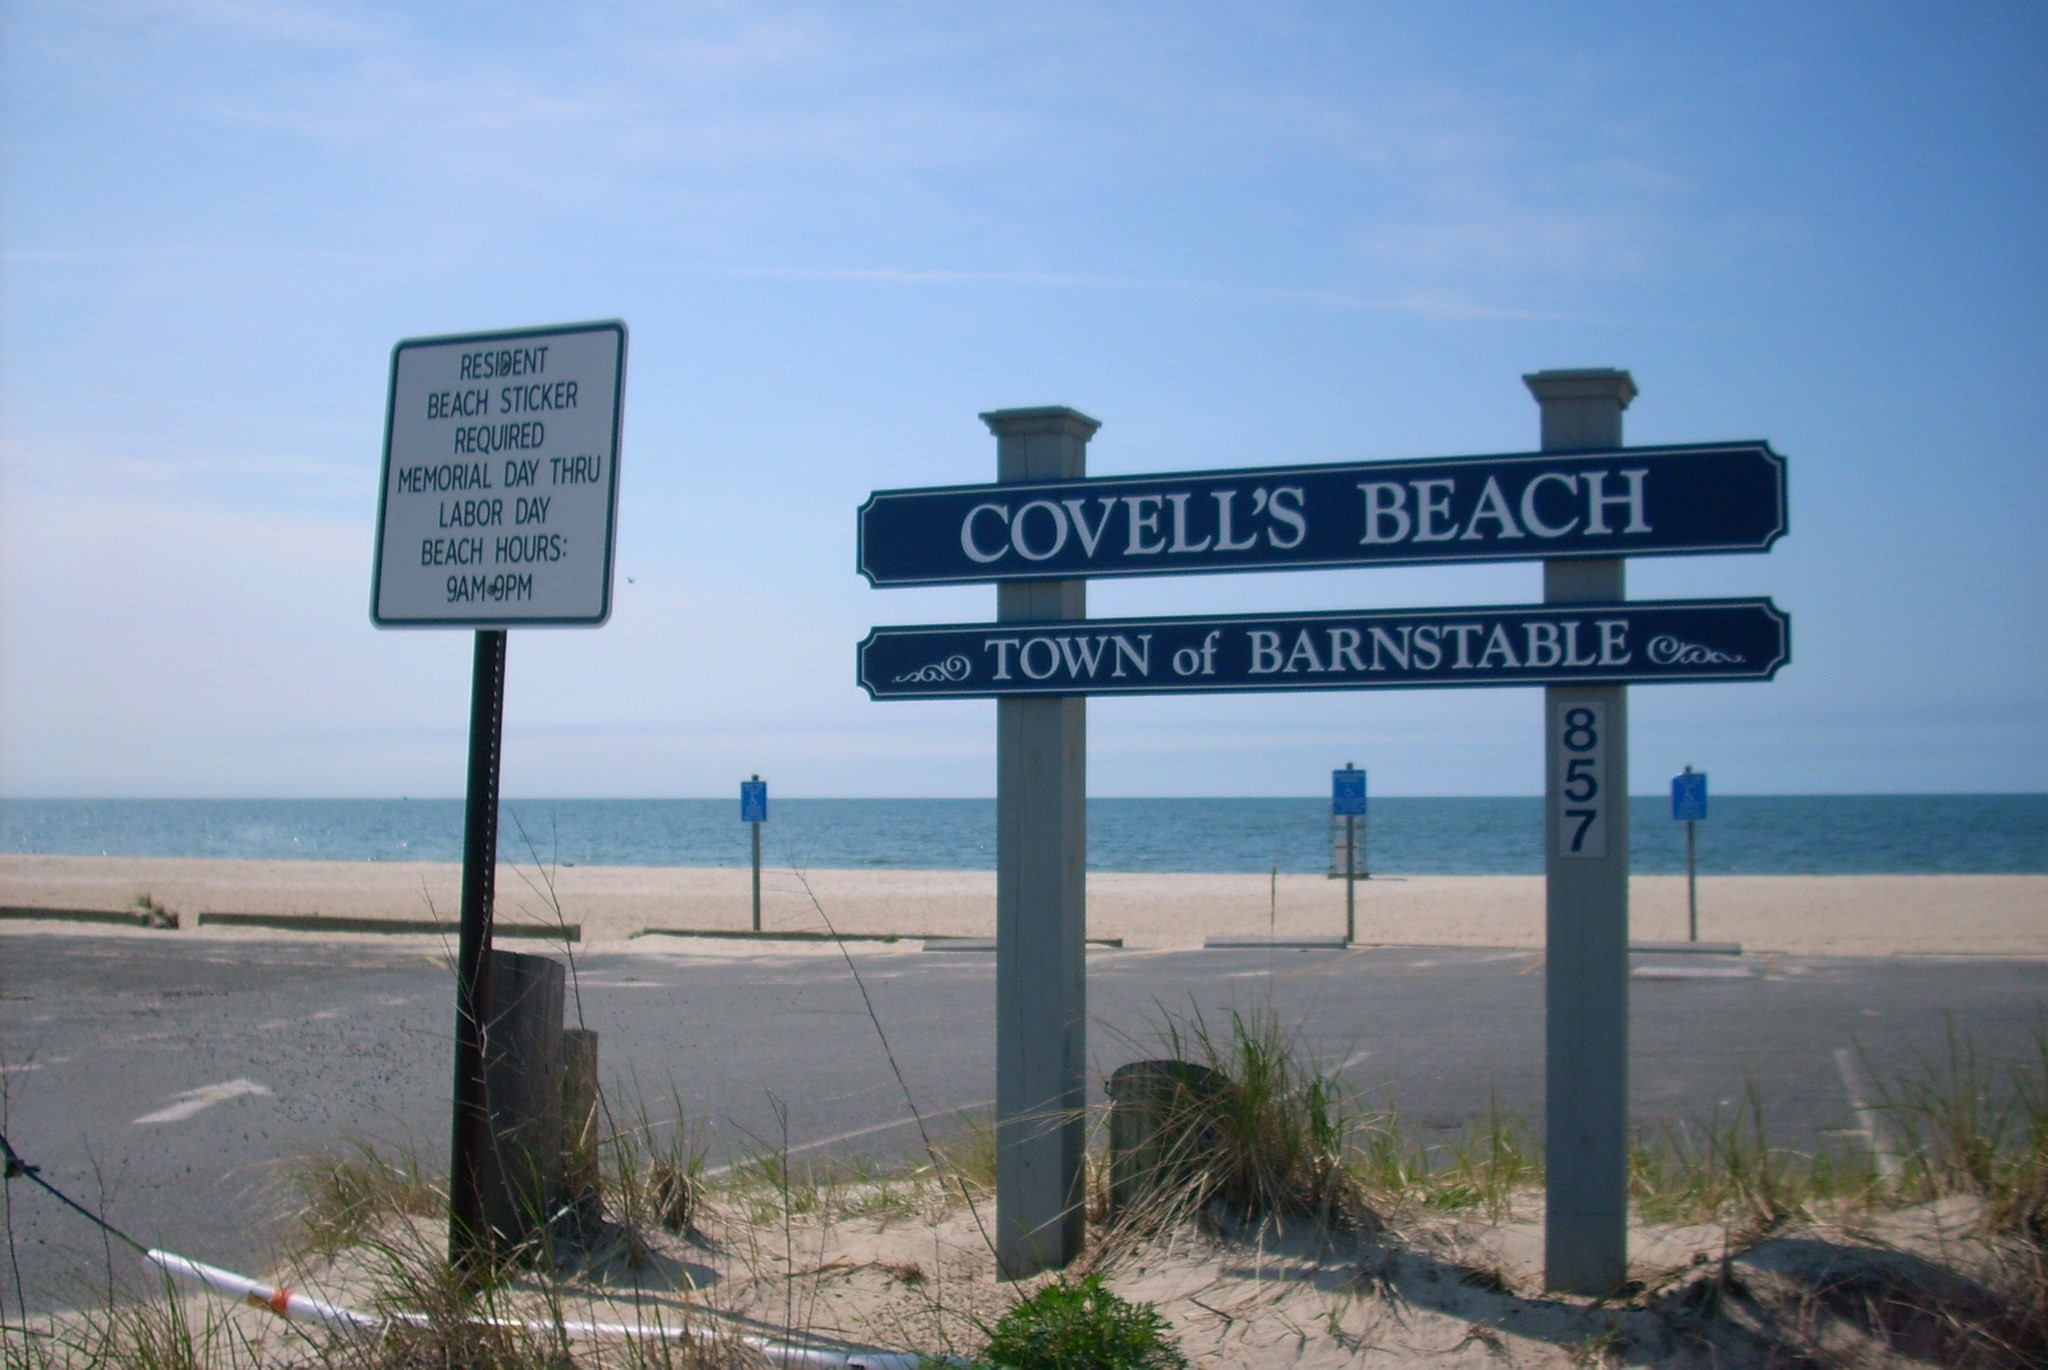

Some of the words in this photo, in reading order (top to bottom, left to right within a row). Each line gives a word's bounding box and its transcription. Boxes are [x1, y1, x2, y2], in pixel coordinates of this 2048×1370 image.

[460, 347, 549, 380] RESIDENT
[427, 389, 488, 419] BEACH
[500, 381, 578, 414] STICKER
[454, 422, 544, 455] REQUIRED
[398, 463, 491, 493] MEMORIAL
[504, 459, 539, 487] DAY
[550, 456, 601, 485] THRU
[439, 500, 502, 528] LABOR
[515, 497, 551, 524] DAY
[961, 486, 1307, 563] COVELL'S
[1357, 469, 1653, 545] BEACH
[421, 538, 483, 566] BEACH
[495, 534, 567, 563] HOURS:
[446, 573, 533, 603] 9AM9PM
[984, 633, 1152, 680] TOWN
[1172, 630, 1220, 677] of
[1246, 619, 1632, 674] BARNSTABLE
[1563, 708, 1598, 853] 857
